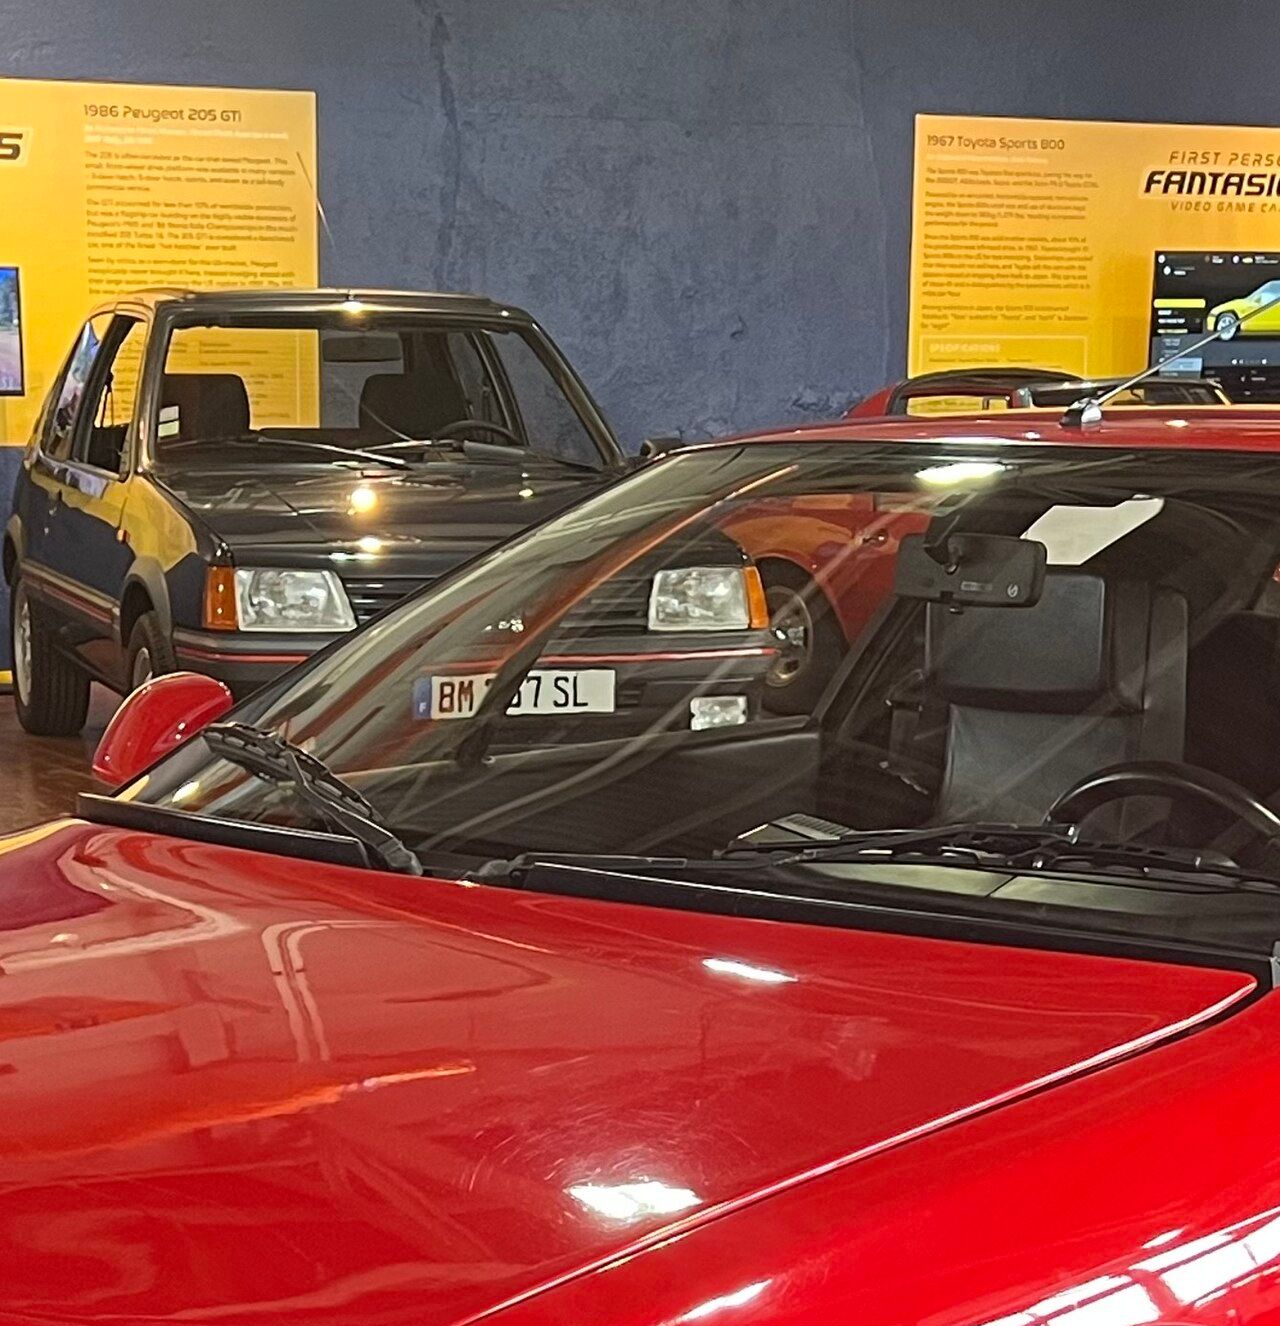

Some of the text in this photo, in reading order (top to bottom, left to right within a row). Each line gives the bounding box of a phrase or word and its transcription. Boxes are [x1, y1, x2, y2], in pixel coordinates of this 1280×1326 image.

[83, 104, 119, 118] 1986
[122, 105, 185, 122] Peugeot
[187, 108, 217, 122] 205
[926, 135, 1065, 151] 1967 Toyota Sports 800
[1169, 151, 1222, 165] FIRST
[1170, 201, 1212, 212] VIDEO
[1216, 202, 1256, 214] GAME
[439, 680, 474, 713] BM
[553, 676, 589, 708] SL
